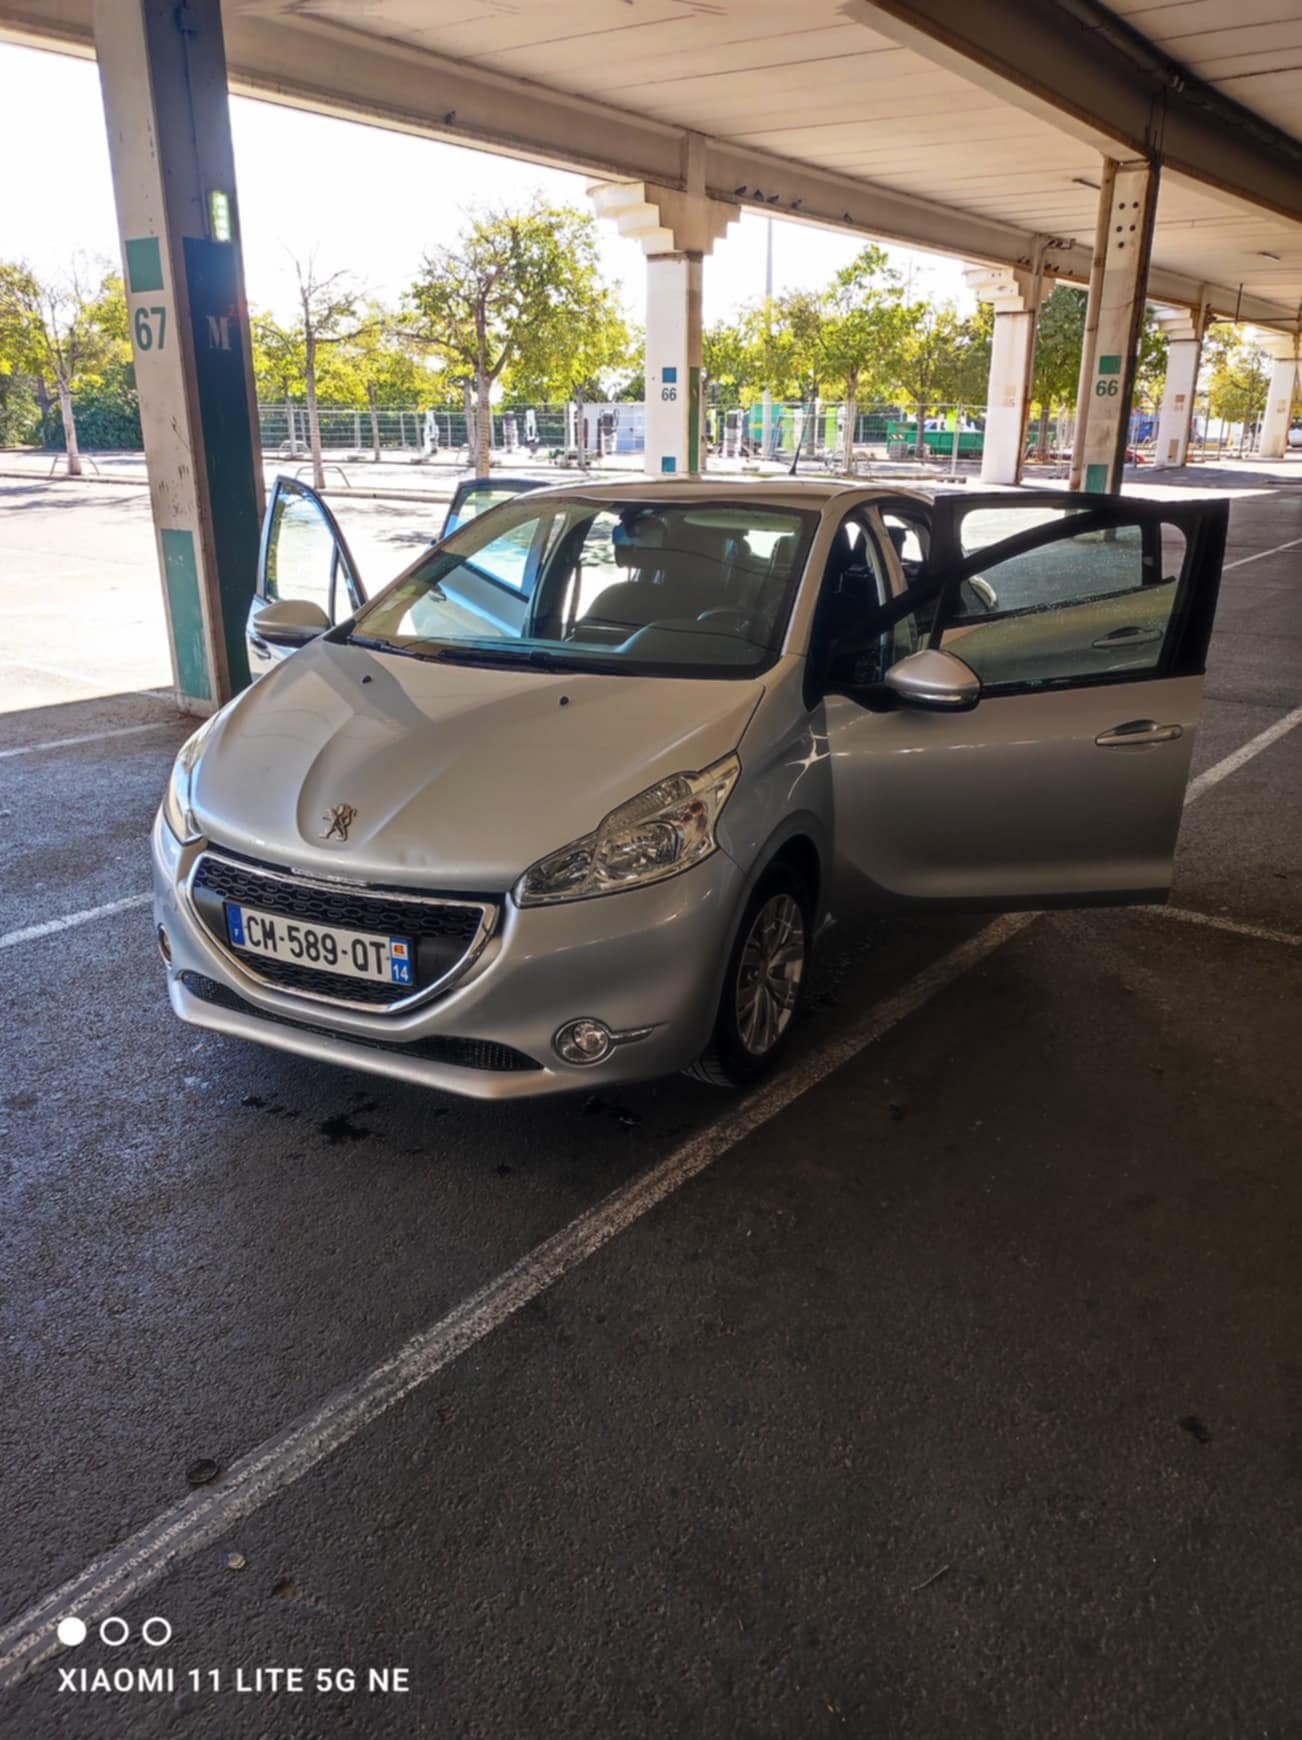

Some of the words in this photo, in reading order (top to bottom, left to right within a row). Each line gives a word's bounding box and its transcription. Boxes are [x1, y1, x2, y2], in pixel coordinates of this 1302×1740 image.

[134, 306, 166, 351] 67
[661, 387, 677, 401] 66
[1095, 379, 1119, 397] 66
[246, 914, 387, 976] CM-589-QT
[392, 963, 409, 982] 14
